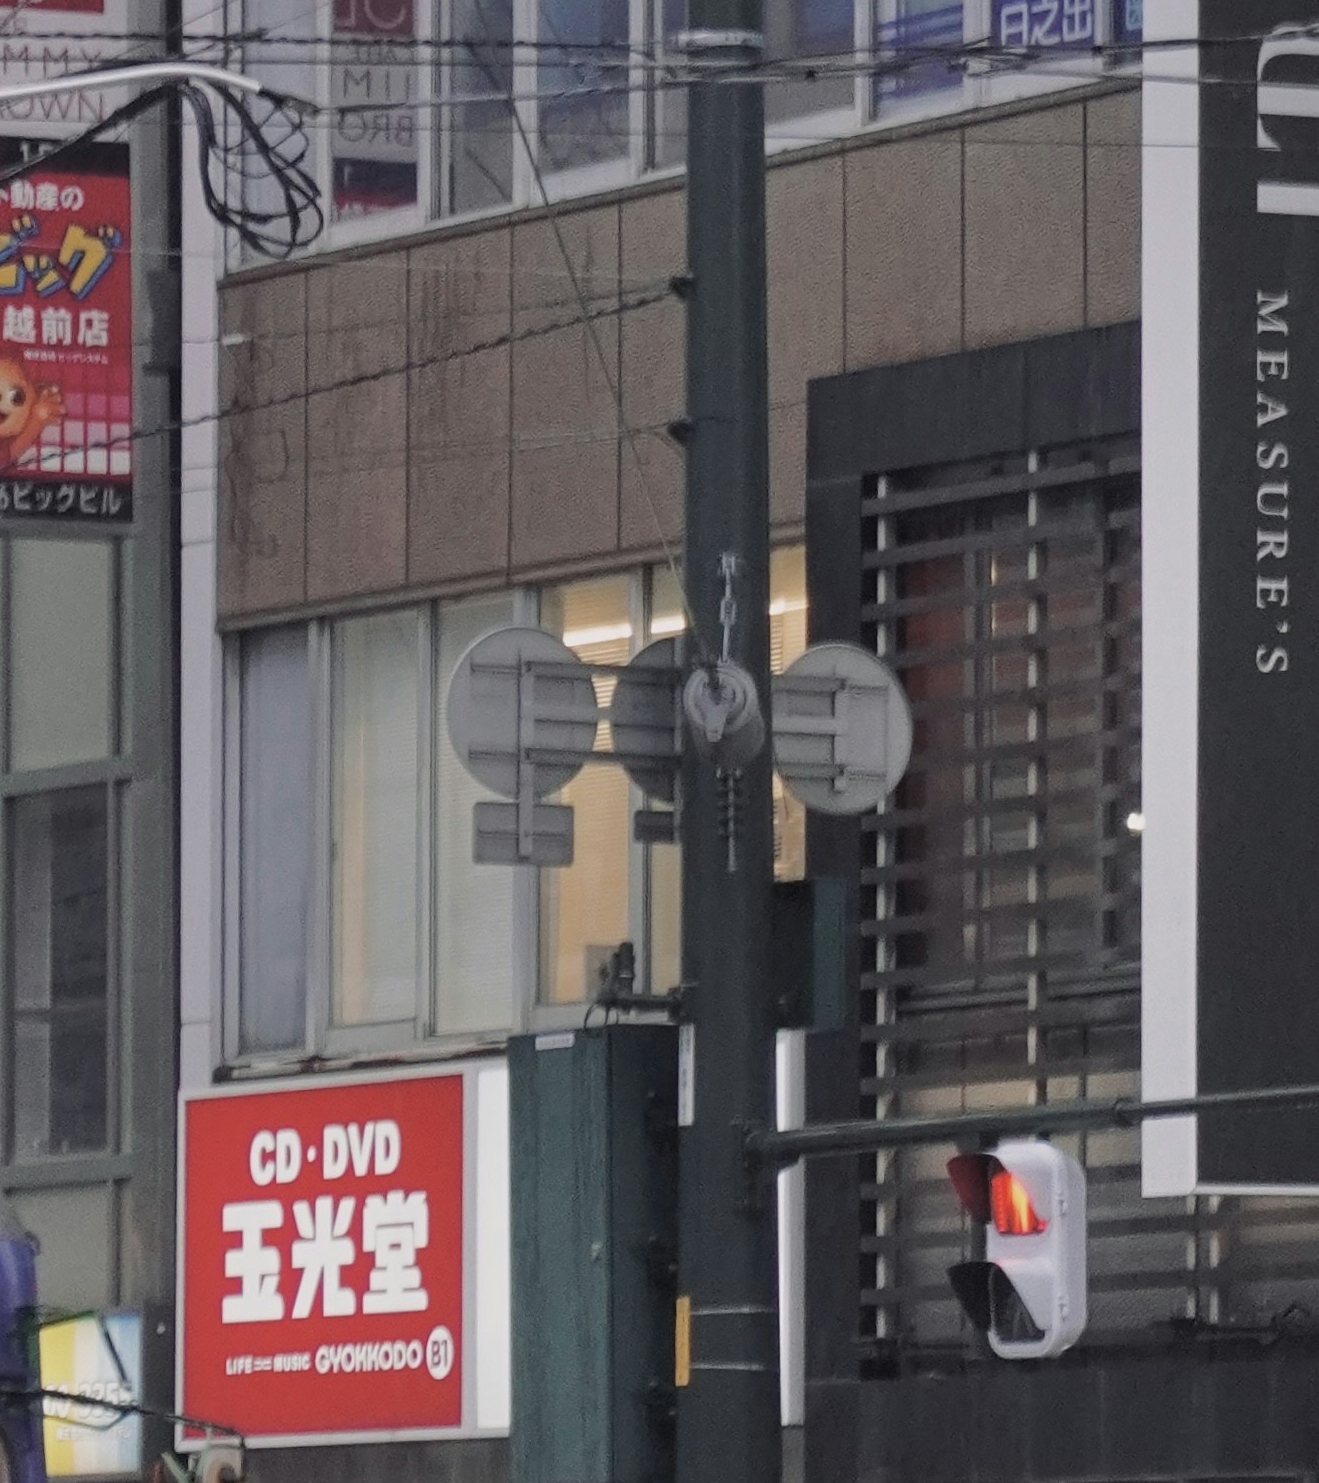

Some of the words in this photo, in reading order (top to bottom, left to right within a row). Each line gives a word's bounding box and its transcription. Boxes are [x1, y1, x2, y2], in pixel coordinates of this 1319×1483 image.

[1256, 289, 1290, 676] MEASURE'S
[221, 1189, 430, 1324] 玉光堂
[315, 1338, 423, 1375] GYOKKODO
